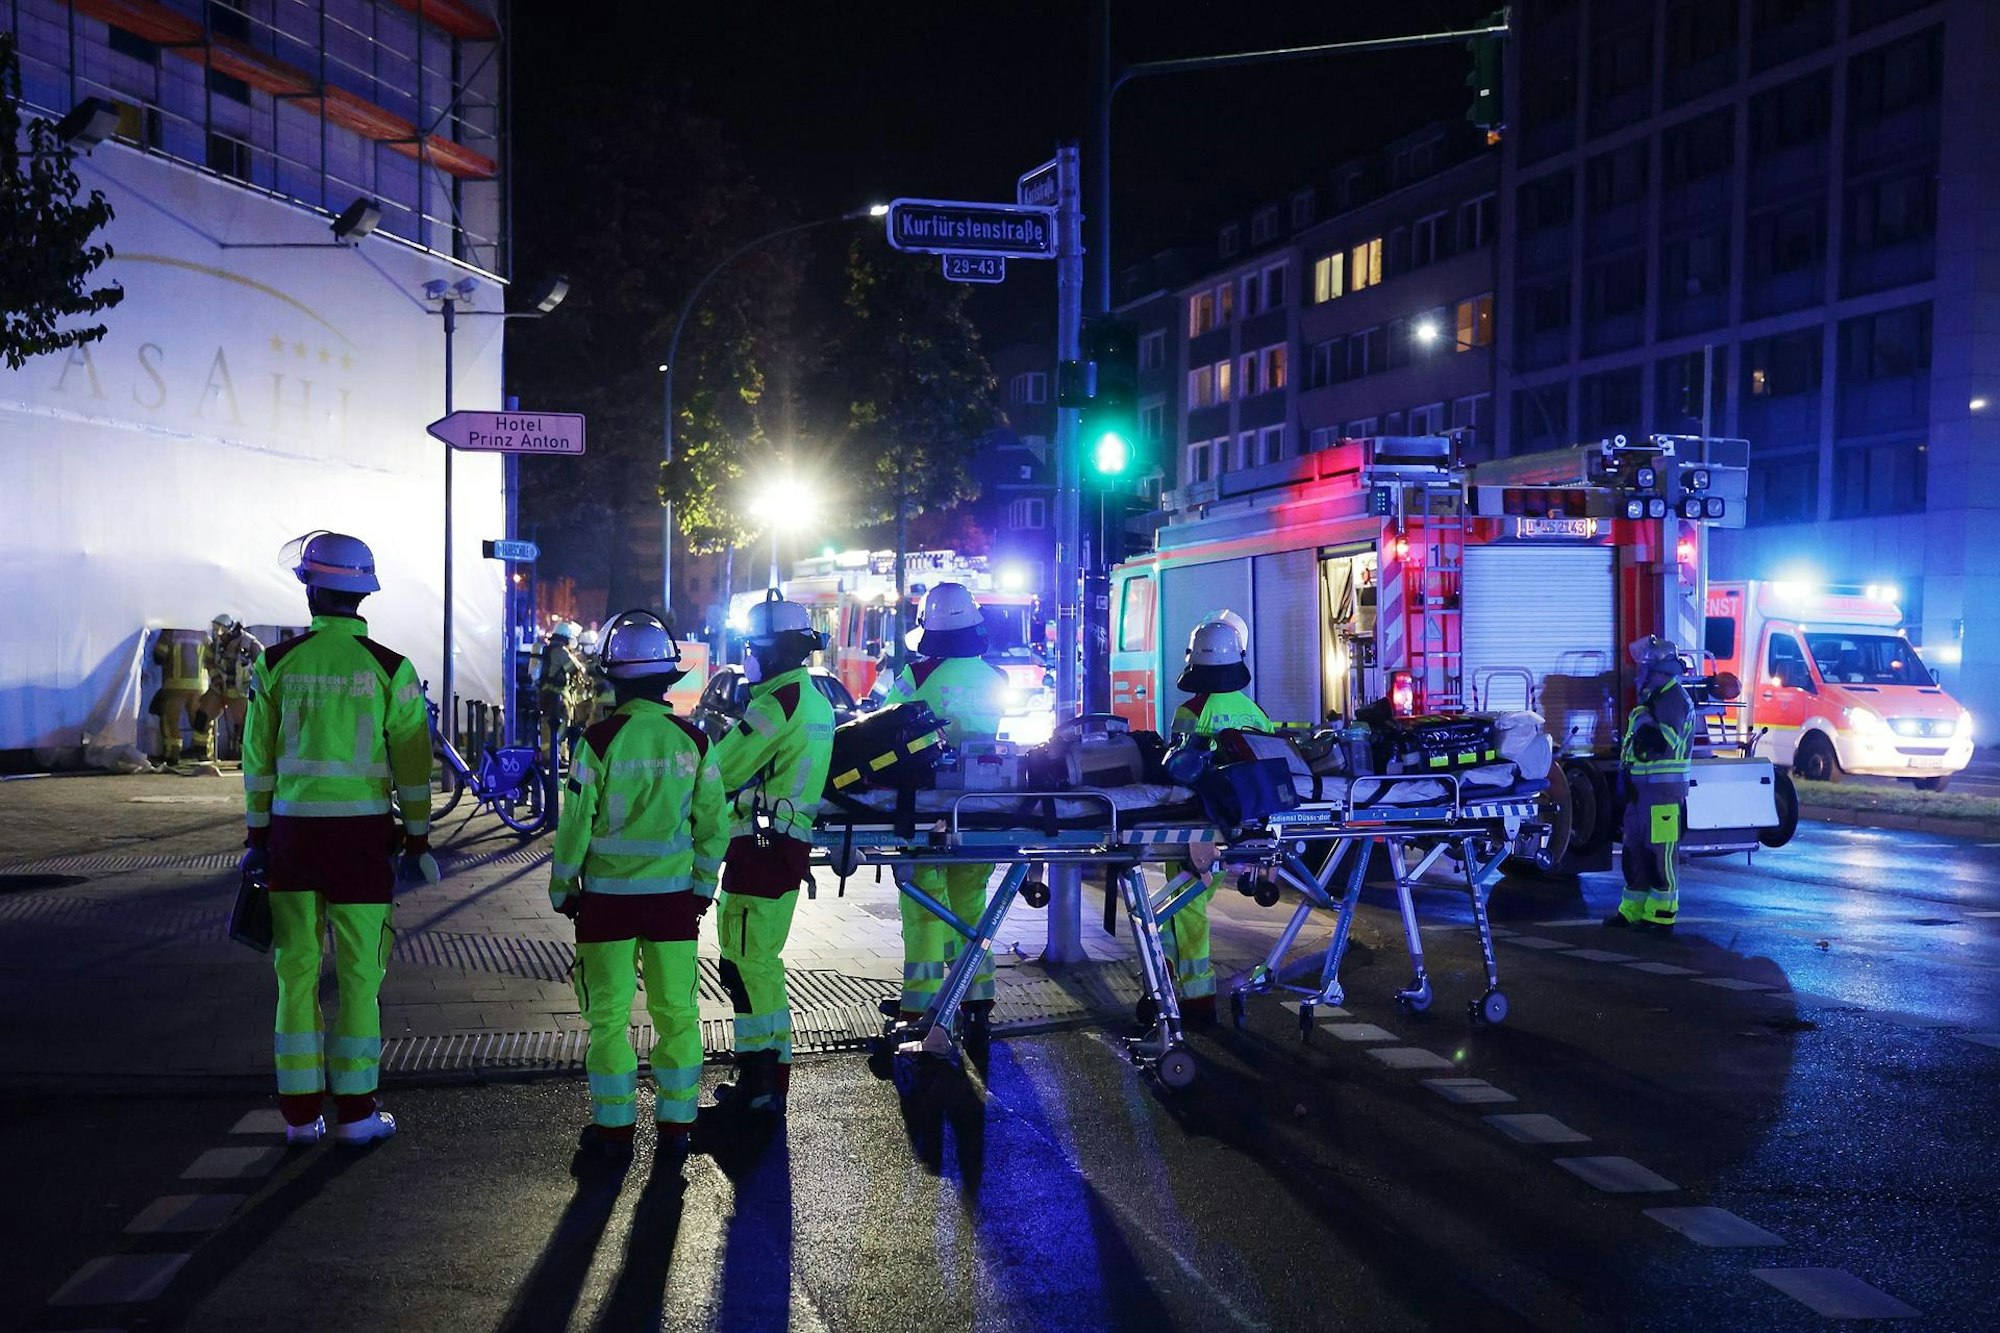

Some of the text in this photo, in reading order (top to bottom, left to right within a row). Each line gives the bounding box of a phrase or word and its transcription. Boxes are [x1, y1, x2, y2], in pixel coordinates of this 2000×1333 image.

[903, 213, 1042, 243] Kurfürstenstraße
[953, 258, 995, 275] 29-43
[496, 416, 542, 432] Hotel
[469, 431, 569, 449] Prinz Anton
